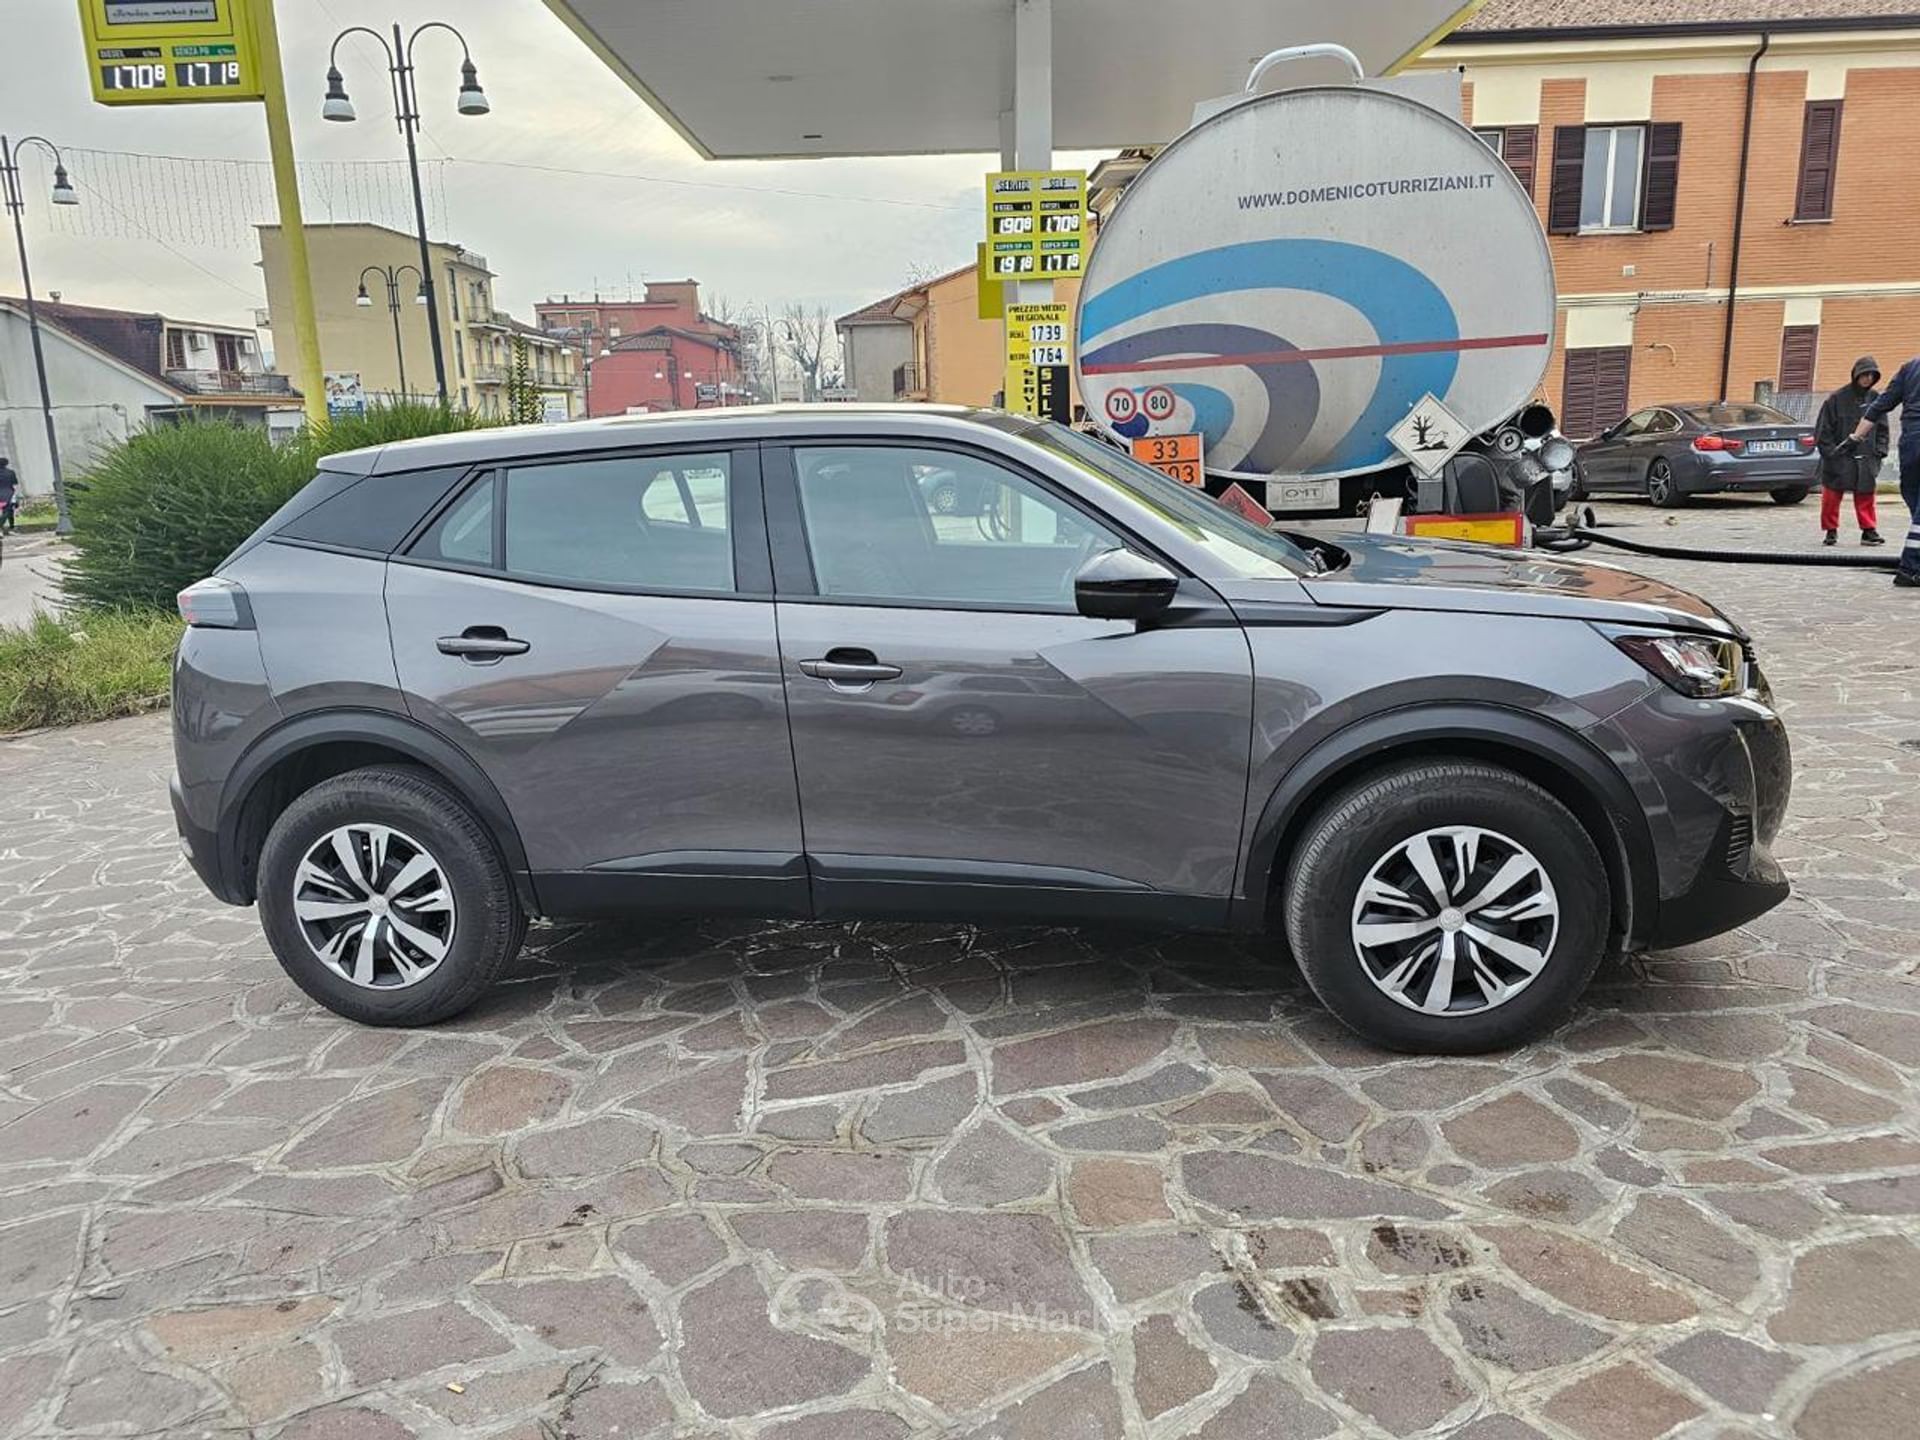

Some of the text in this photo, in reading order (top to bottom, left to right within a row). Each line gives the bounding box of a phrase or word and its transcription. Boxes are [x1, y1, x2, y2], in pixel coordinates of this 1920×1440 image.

[114, 64, 166, 89] 1708
[188, 62, 239, 87] 1718
[1049, 178, 1067, 188] SELF
[1238, 174, 1495, 210] WWW.DOMENICOTURRIZIANI.IT
[1000, 217, 1032, 233] 1908
[1046, 215, 1079, 232] 1708
[1000, 256, 1033, 272] 1918
[1046, 254, 1079, 271] 1718
[1008, 304, 1067, 313] PREZZO MEDIO
[1016, 313, 1060, 321] REGIONALE
[1032, 325, 1061, 341] 1739
[1032, 347, 1063, 363] 1764
[1113, 397, 1130, 412] 70
[1150, 395, 1168, 410] 80
[1153, 440, 1179, 460] 33
